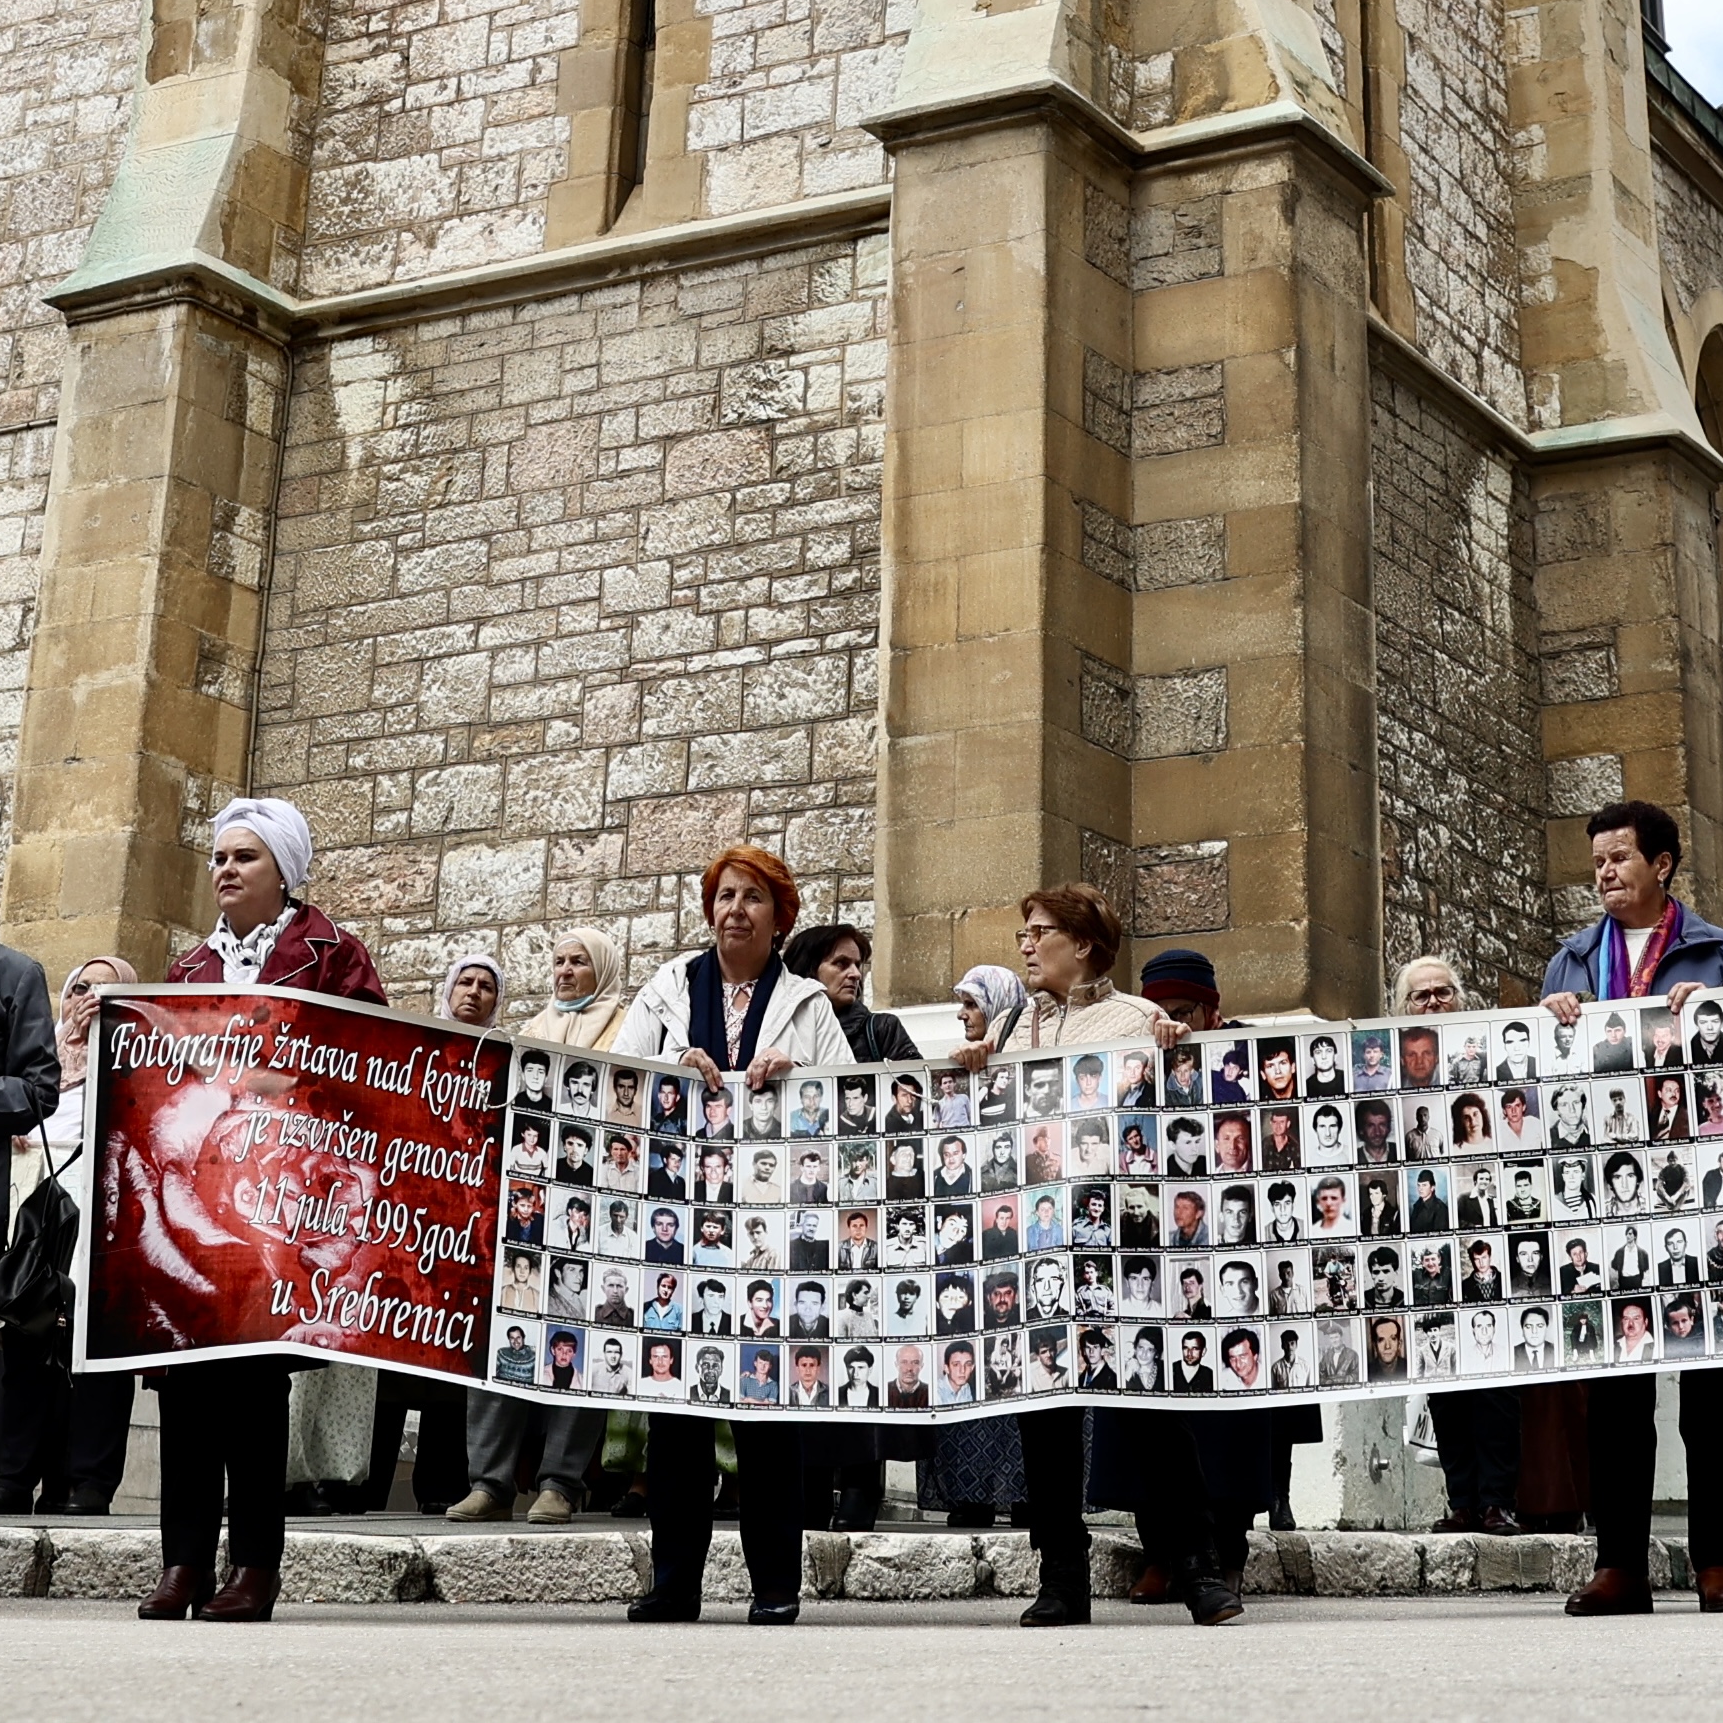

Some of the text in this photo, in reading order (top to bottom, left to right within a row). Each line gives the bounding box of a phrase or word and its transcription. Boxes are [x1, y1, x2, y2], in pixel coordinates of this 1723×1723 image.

[110, 1014, 262, 1086] Fotografije
[269, 1022, 358, 1083] žrtava
[366, 1046, 423, 1096] nad
[420, 1049, 492, 1122] kojim
[234, 1095, 268, 1163] je
[278, 1097, 378, 1164] izvršen
[379, 1136, 495, 1188] genocid
[248, 1176, 284, 1226] 11
[284, 1181, 348, 1245] jula
[270, 1278, 293, 1317] u
[299, 1267, 480, 1353] Srebrenici
